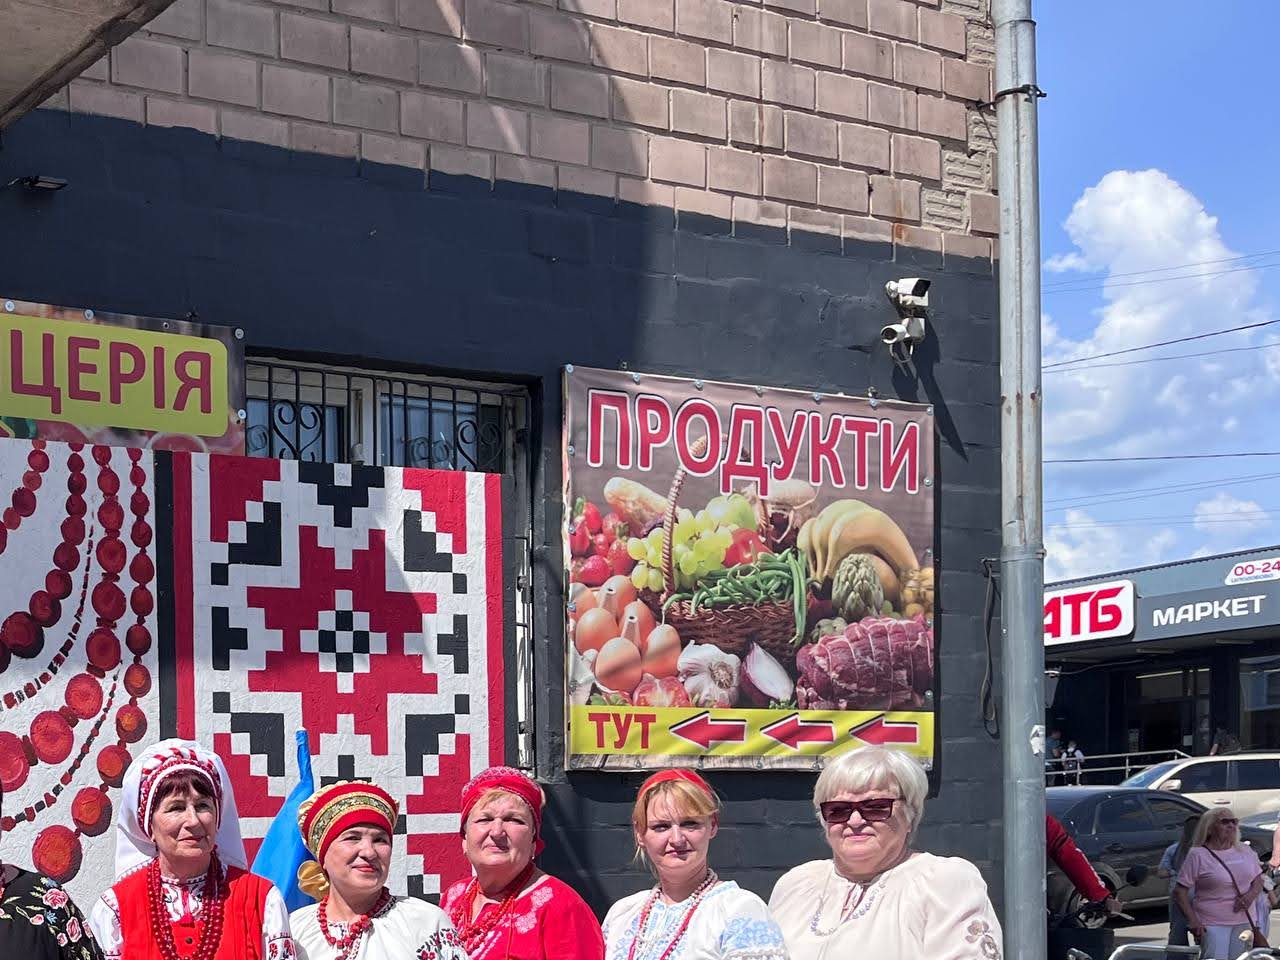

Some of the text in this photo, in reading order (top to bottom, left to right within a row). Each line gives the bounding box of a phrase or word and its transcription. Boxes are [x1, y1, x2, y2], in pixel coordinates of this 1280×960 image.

[586, 389, 920, 497] ПРОДУКТИ
[1152, 594, 1267, 627] МАРКЕТ
[587, 712, 657, 750] ТУТ
